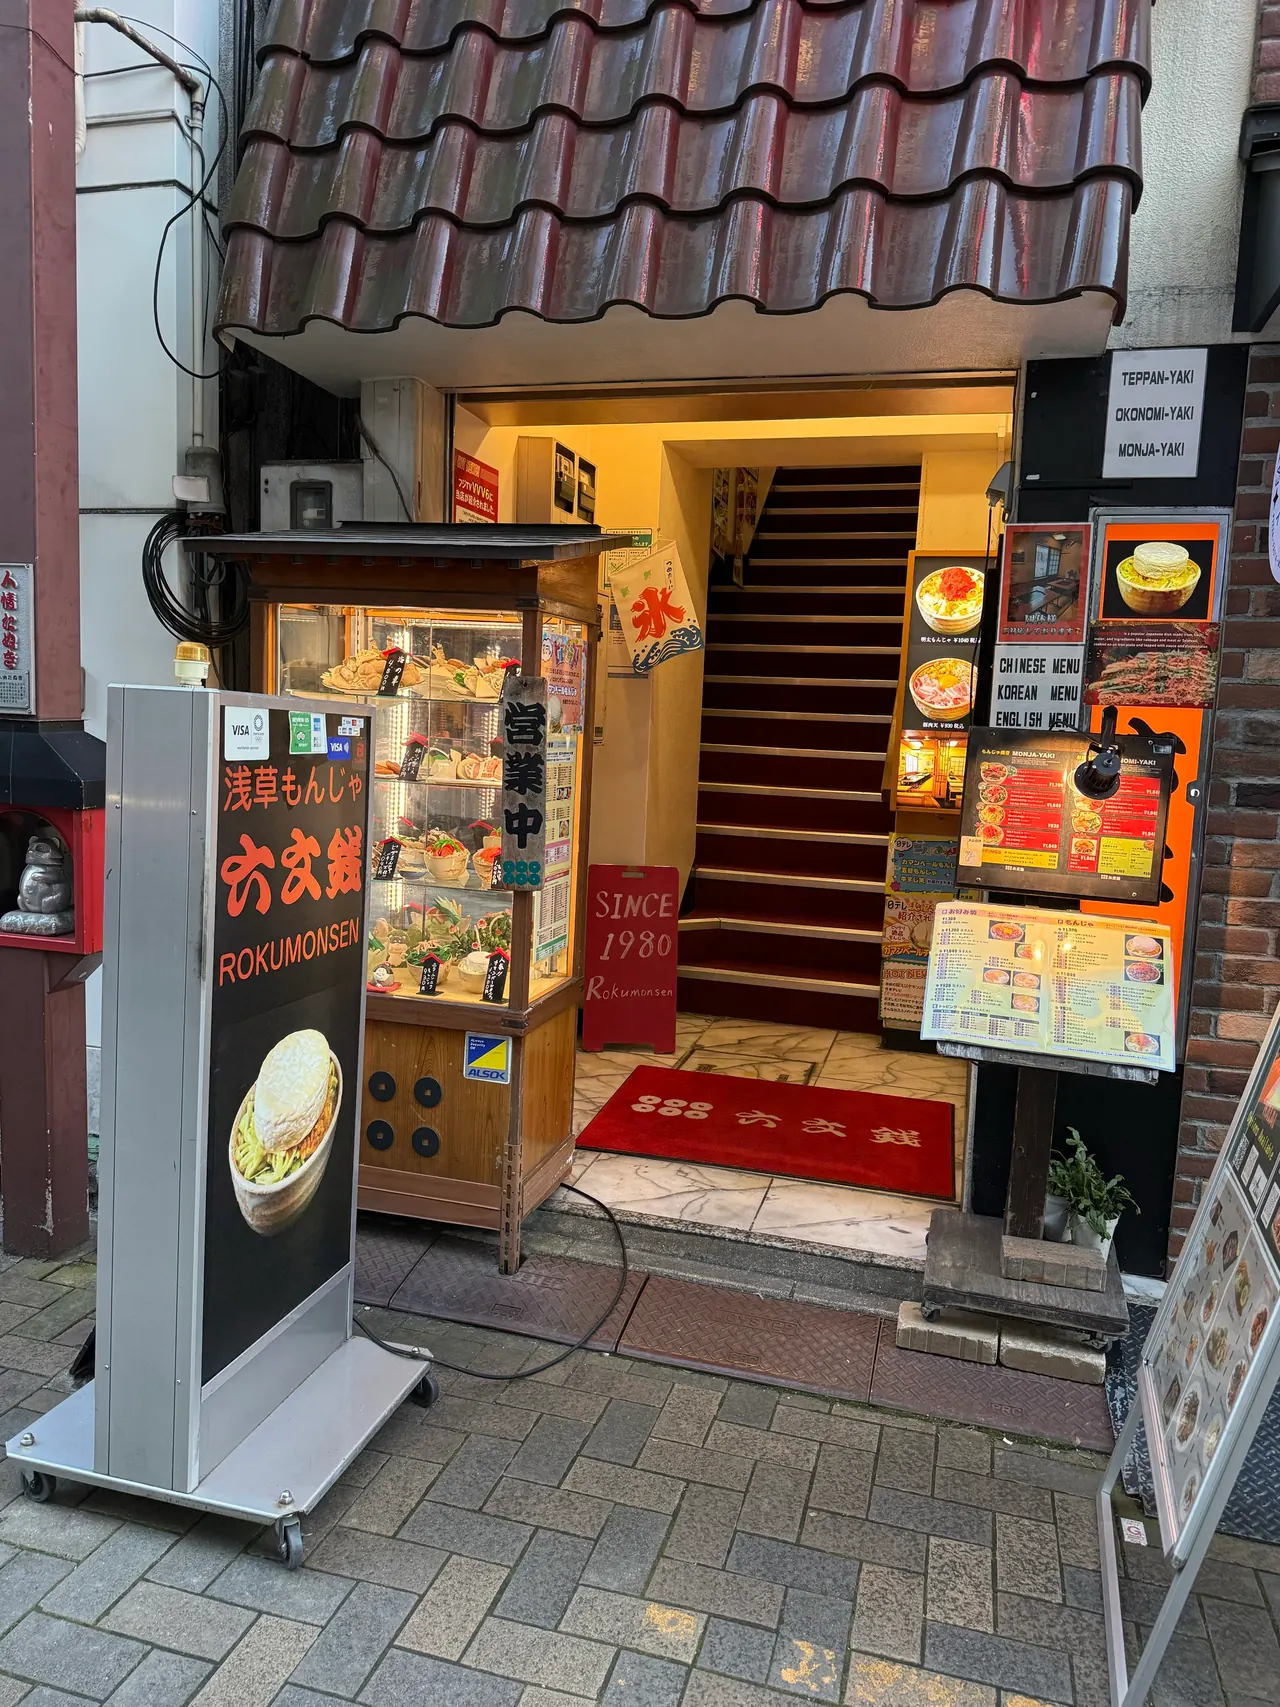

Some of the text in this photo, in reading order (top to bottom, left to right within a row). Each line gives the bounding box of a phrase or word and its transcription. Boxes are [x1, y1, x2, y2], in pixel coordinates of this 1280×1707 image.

[1121, 369, 1195, 386] TEPPAN-YAKI
[1115, 405, 1195, 422] OKONOMI-YAKI
[1118, 442, 1185, 457] MONJA-YAKI
[630, 586, 687, 643] 氷
[999, 657, 1081, 674] CHINESE MENU
[997, 684, 1078, 701] KOREAN MENU
[995, 711, 1076, 729] ENGLISH MENU
[231, 724, 250, 736] VISA
[329, 742, 343, 752] VISA
[1012, 750, 1055, 759] MONJA-YAKI
[503, 701, 547, 849] 営業中
[223, 765, 363, 812] 浅草もんじゃ
[595, 890, 674, 919] SINCE
[219, 916, 360, 987] ROKUMONSEN
[599, 930, 673, 961] 1980
[883, 969, 905, 979] HOT
[586, 975, 674, 1001] Rokumonsen
[467, 1068, 506, 1081] ALSOK
